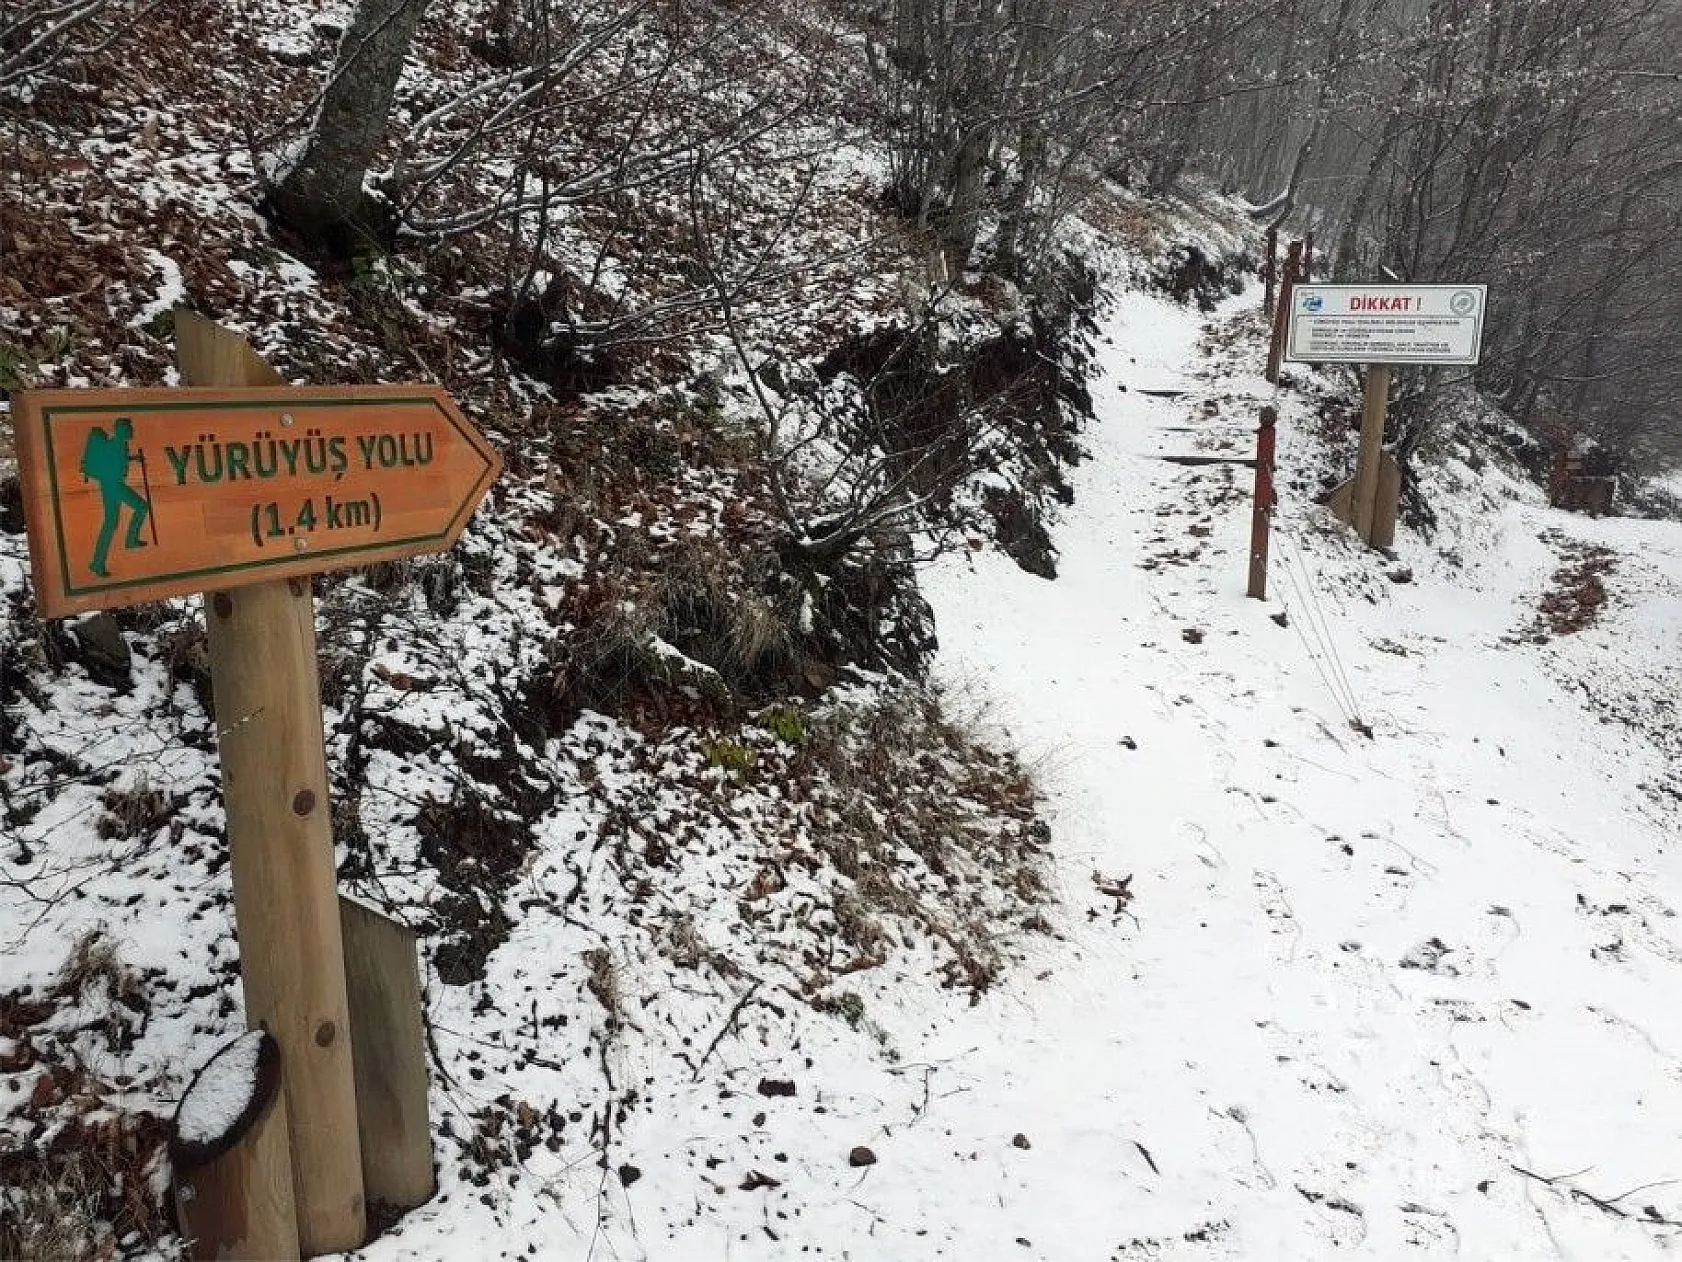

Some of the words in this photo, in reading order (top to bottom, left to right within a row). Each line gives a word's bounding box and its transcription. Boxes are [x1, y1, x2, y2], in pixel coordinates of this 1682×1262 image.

[1350, 294, 1412, 311] DİKKAT
[165, 429, 347, 485] YÜRÜYÜŞ
[358, 432, 434, 471] YOLU
[250, 501, 317, 547] (1.4
[326, 492, 382, 532] km)
